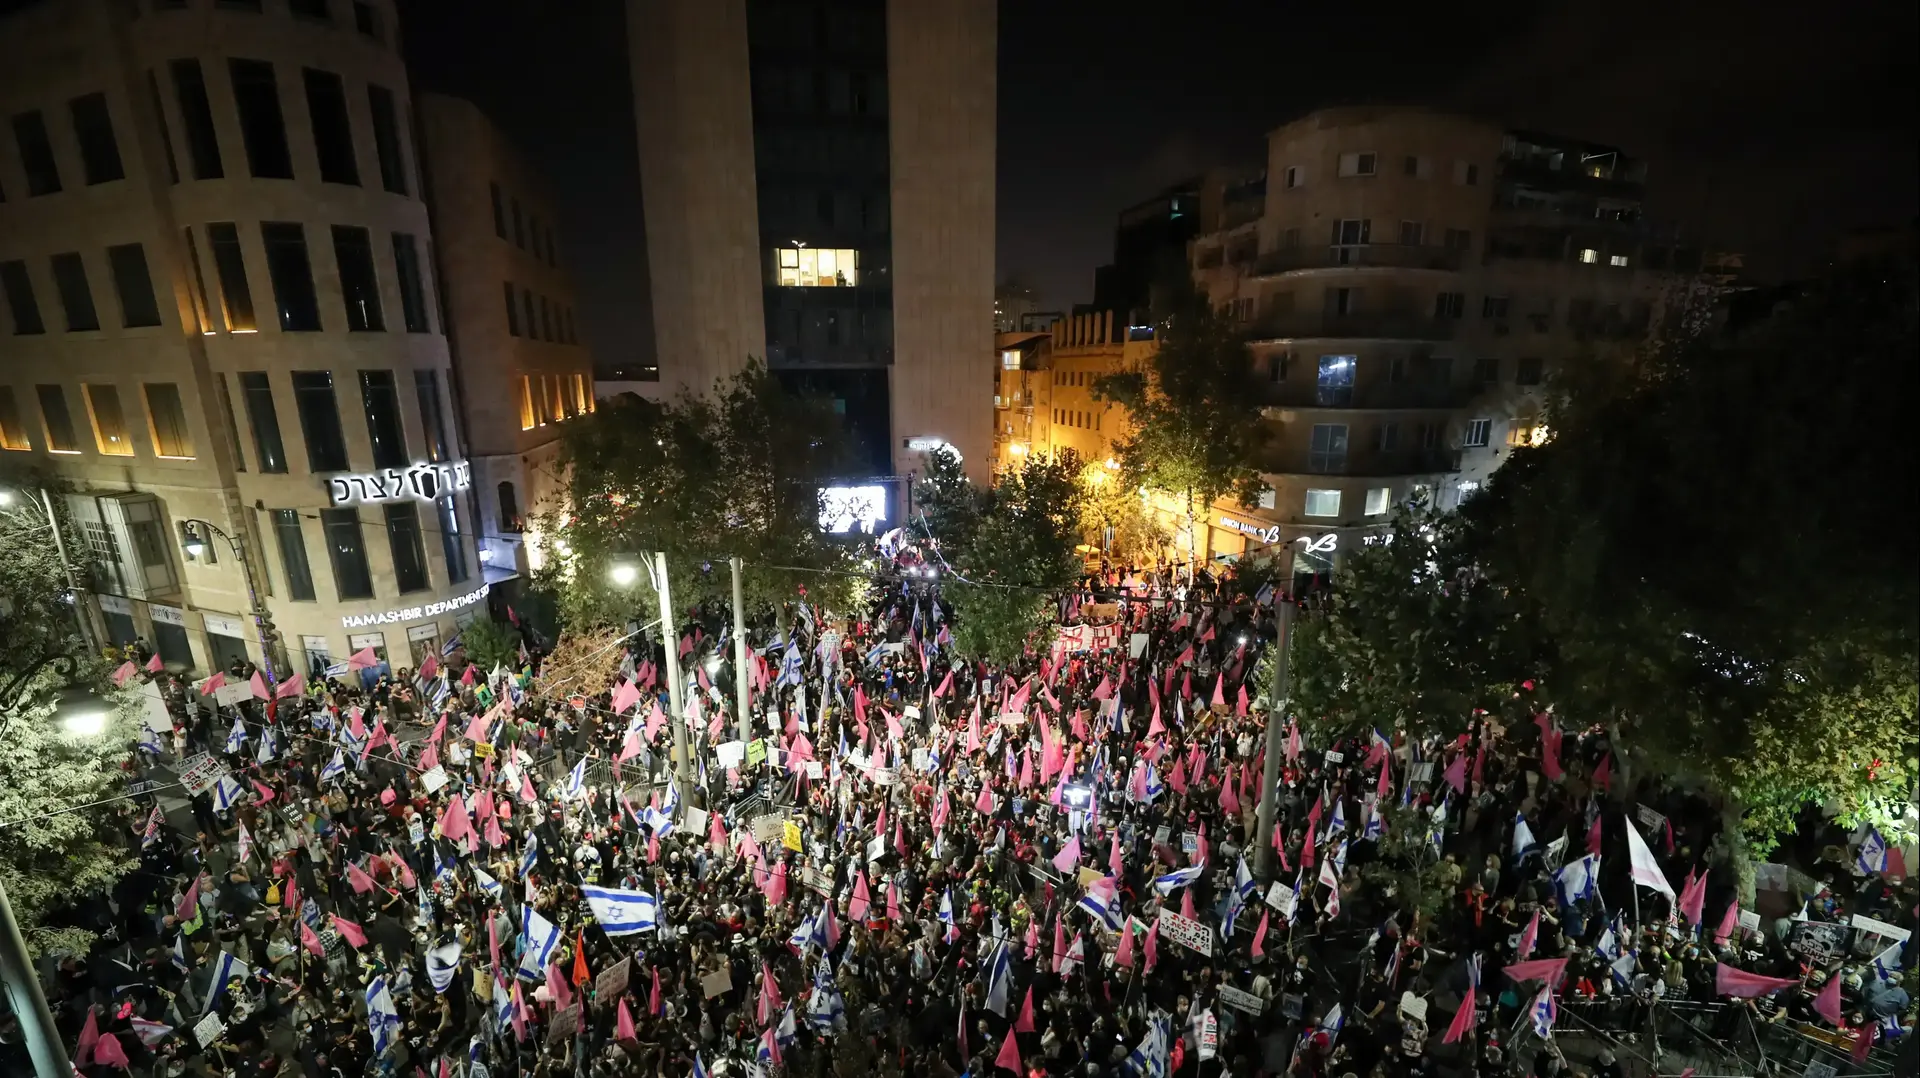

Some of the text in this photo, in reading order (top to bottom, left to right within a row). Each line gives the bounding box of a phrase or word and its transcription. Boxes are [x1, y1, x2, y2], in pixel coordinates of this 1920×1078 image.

[1220, 516, 1240, 530] UNION
[1240, 522, 1258, 535] BANK
[342, 607, 422, 628] HAMASHBIR
[425, 590, 481, 617] DEPARTMENT
